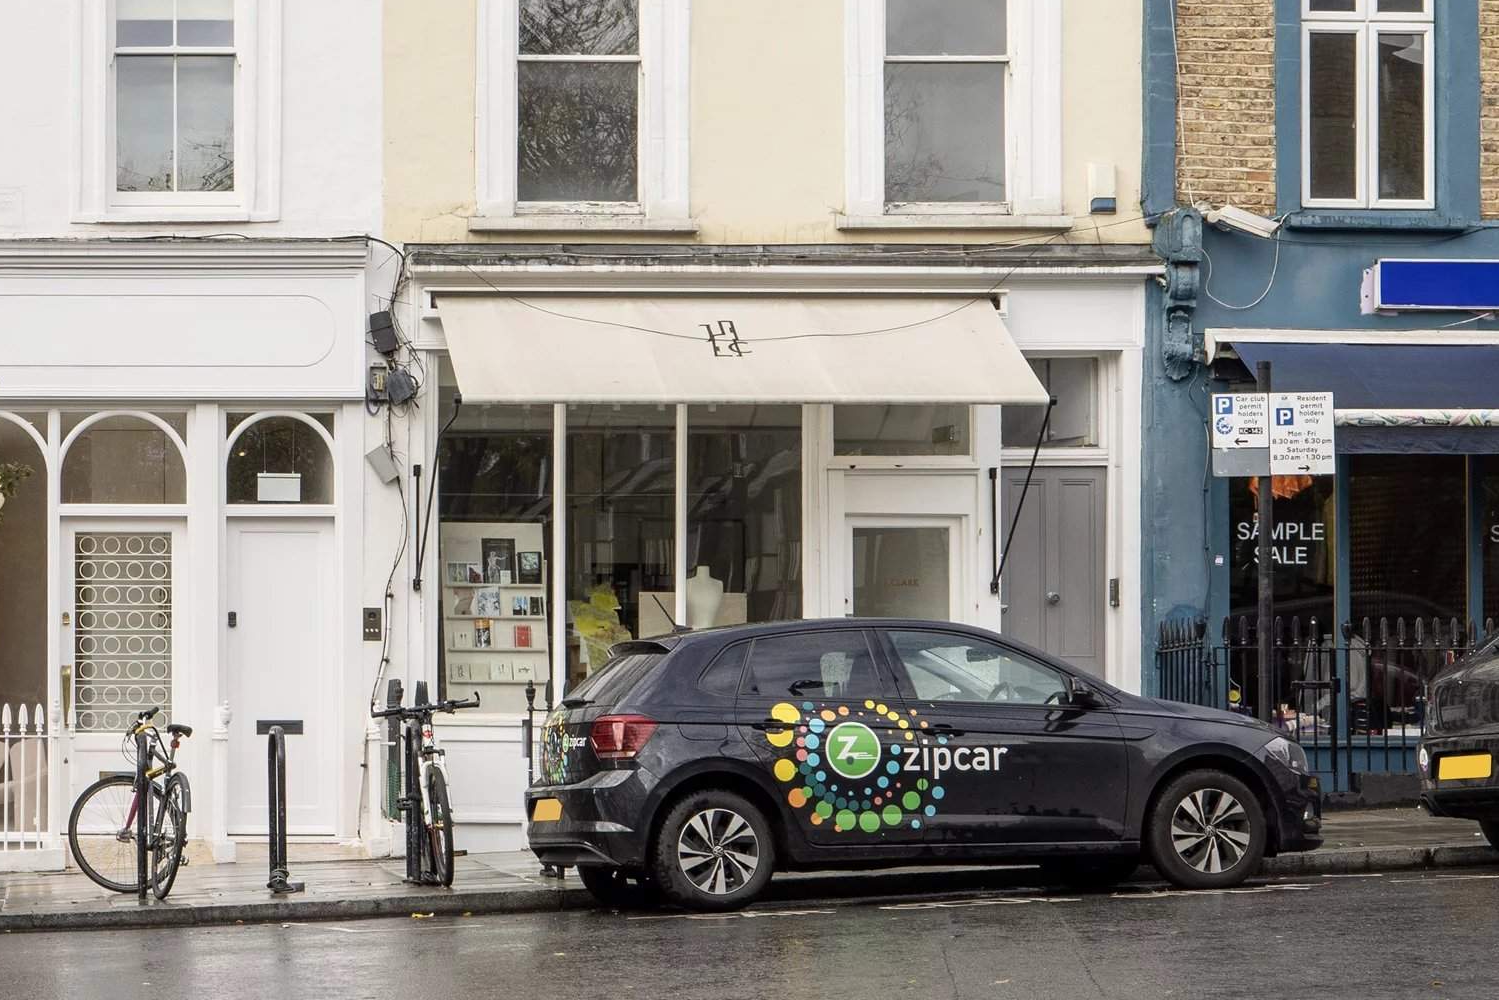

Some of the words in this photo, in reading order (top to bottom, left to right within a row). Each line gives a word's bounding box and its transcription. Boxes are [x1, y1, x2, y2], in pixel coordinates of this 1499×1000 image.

[1218, 398, 1229, 413] P
[1280, 410, 1291, 424] P
[1237, 522, 1324, 540] SAMPLE
[903, 739, 1008, 780] zipcar
